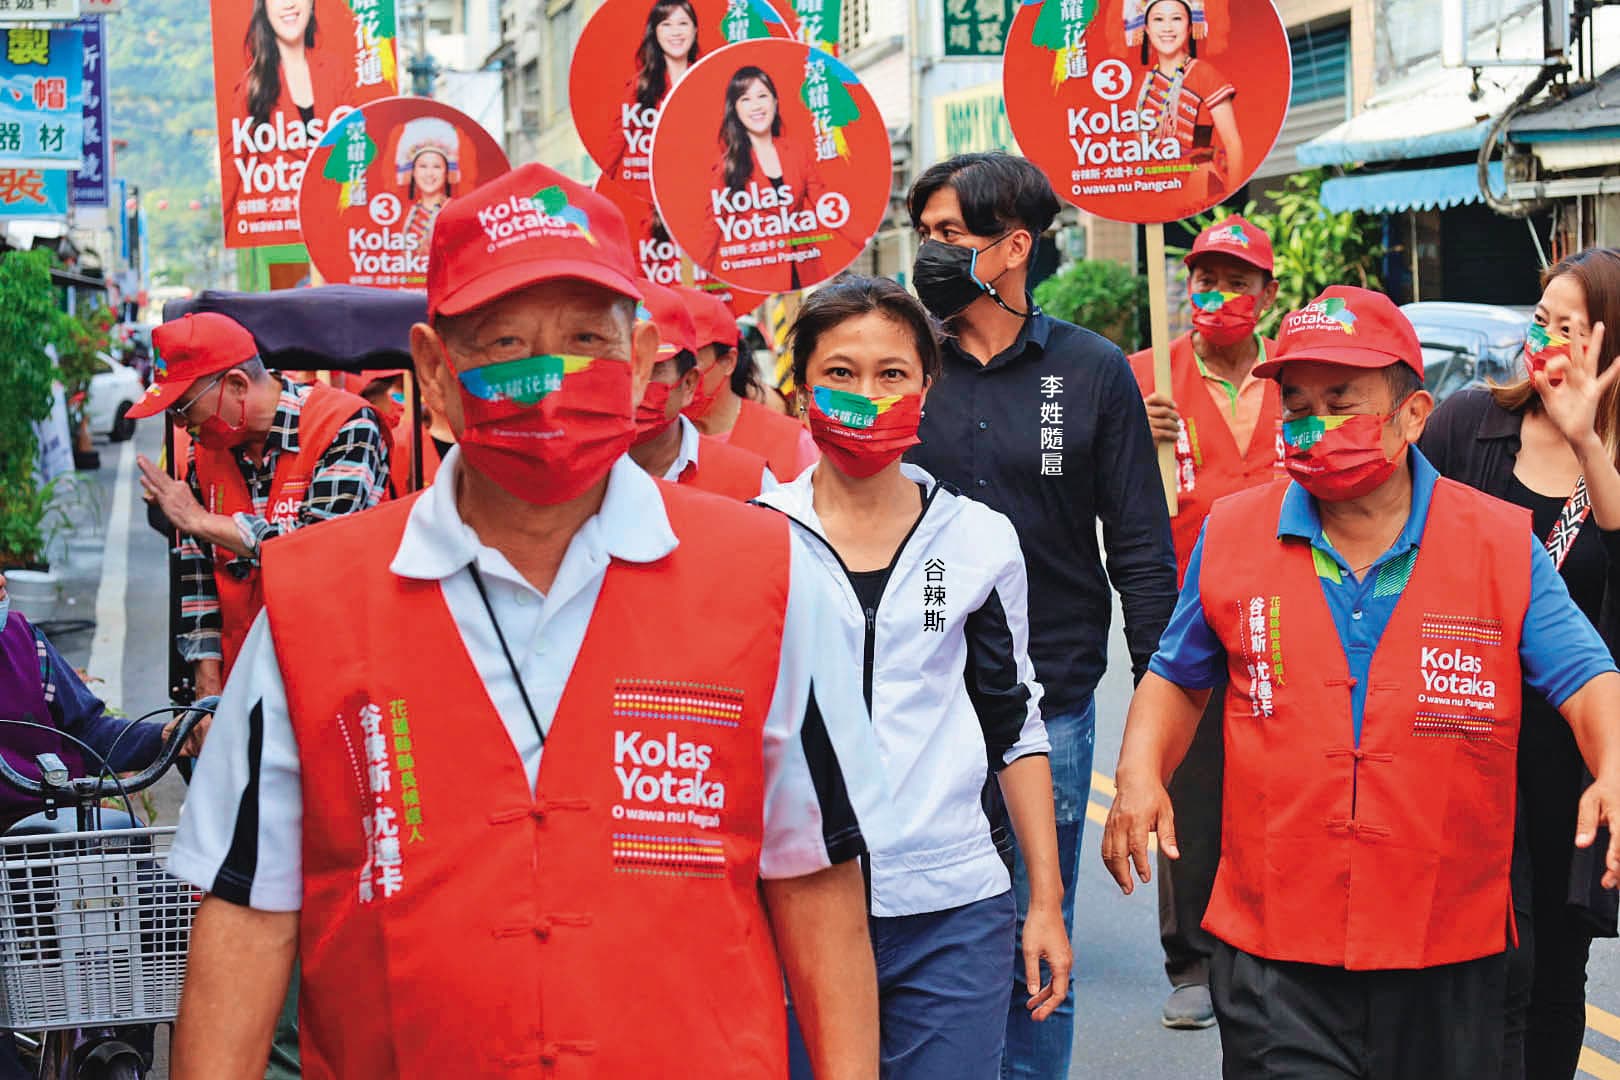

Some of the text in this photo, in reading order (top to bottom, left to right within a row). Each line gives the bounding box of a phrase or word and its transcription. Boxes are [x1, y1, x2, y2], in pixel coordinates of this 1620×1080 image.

[1096, 60, 1129, 98] 3
[232, 111, 324, 154] Kolas
[1067, 103, 1158, 136] Kolas
[1069, 132, 1182, 166] Yotaka
[234, 155, 304, 194] Yota
[1083, 182, 1116, 194] wawa
[1117, 181, 1132, 192] nu
[1134, 178, 1182, 192] Pangcah
[477, 195, 546, 227] Kolas
[711, 181, 794, 215] Kolas
[819, 194, 847, 226] 3
[348, 227, 418, 250] Kolas
[484, 211, 568, 241] Yotaka
[715, 206, 818, 242] Yotaka
[1421, 646, 1482, 674] Kolas
[1418, 693, 1426, 703] O
[1427, 695, 1451, 705] wawa
[1451, 698, 1463, 706] nu
[1420, 669, 1496, 698] Yotaka
[614, 730, 713, 771] Kolas
[613, 765, 726, 809] Yotaka
[611, 804, 625, 819] O
[626, 808, 665, 822] wawa
[666, 811, 686, 823] nu
